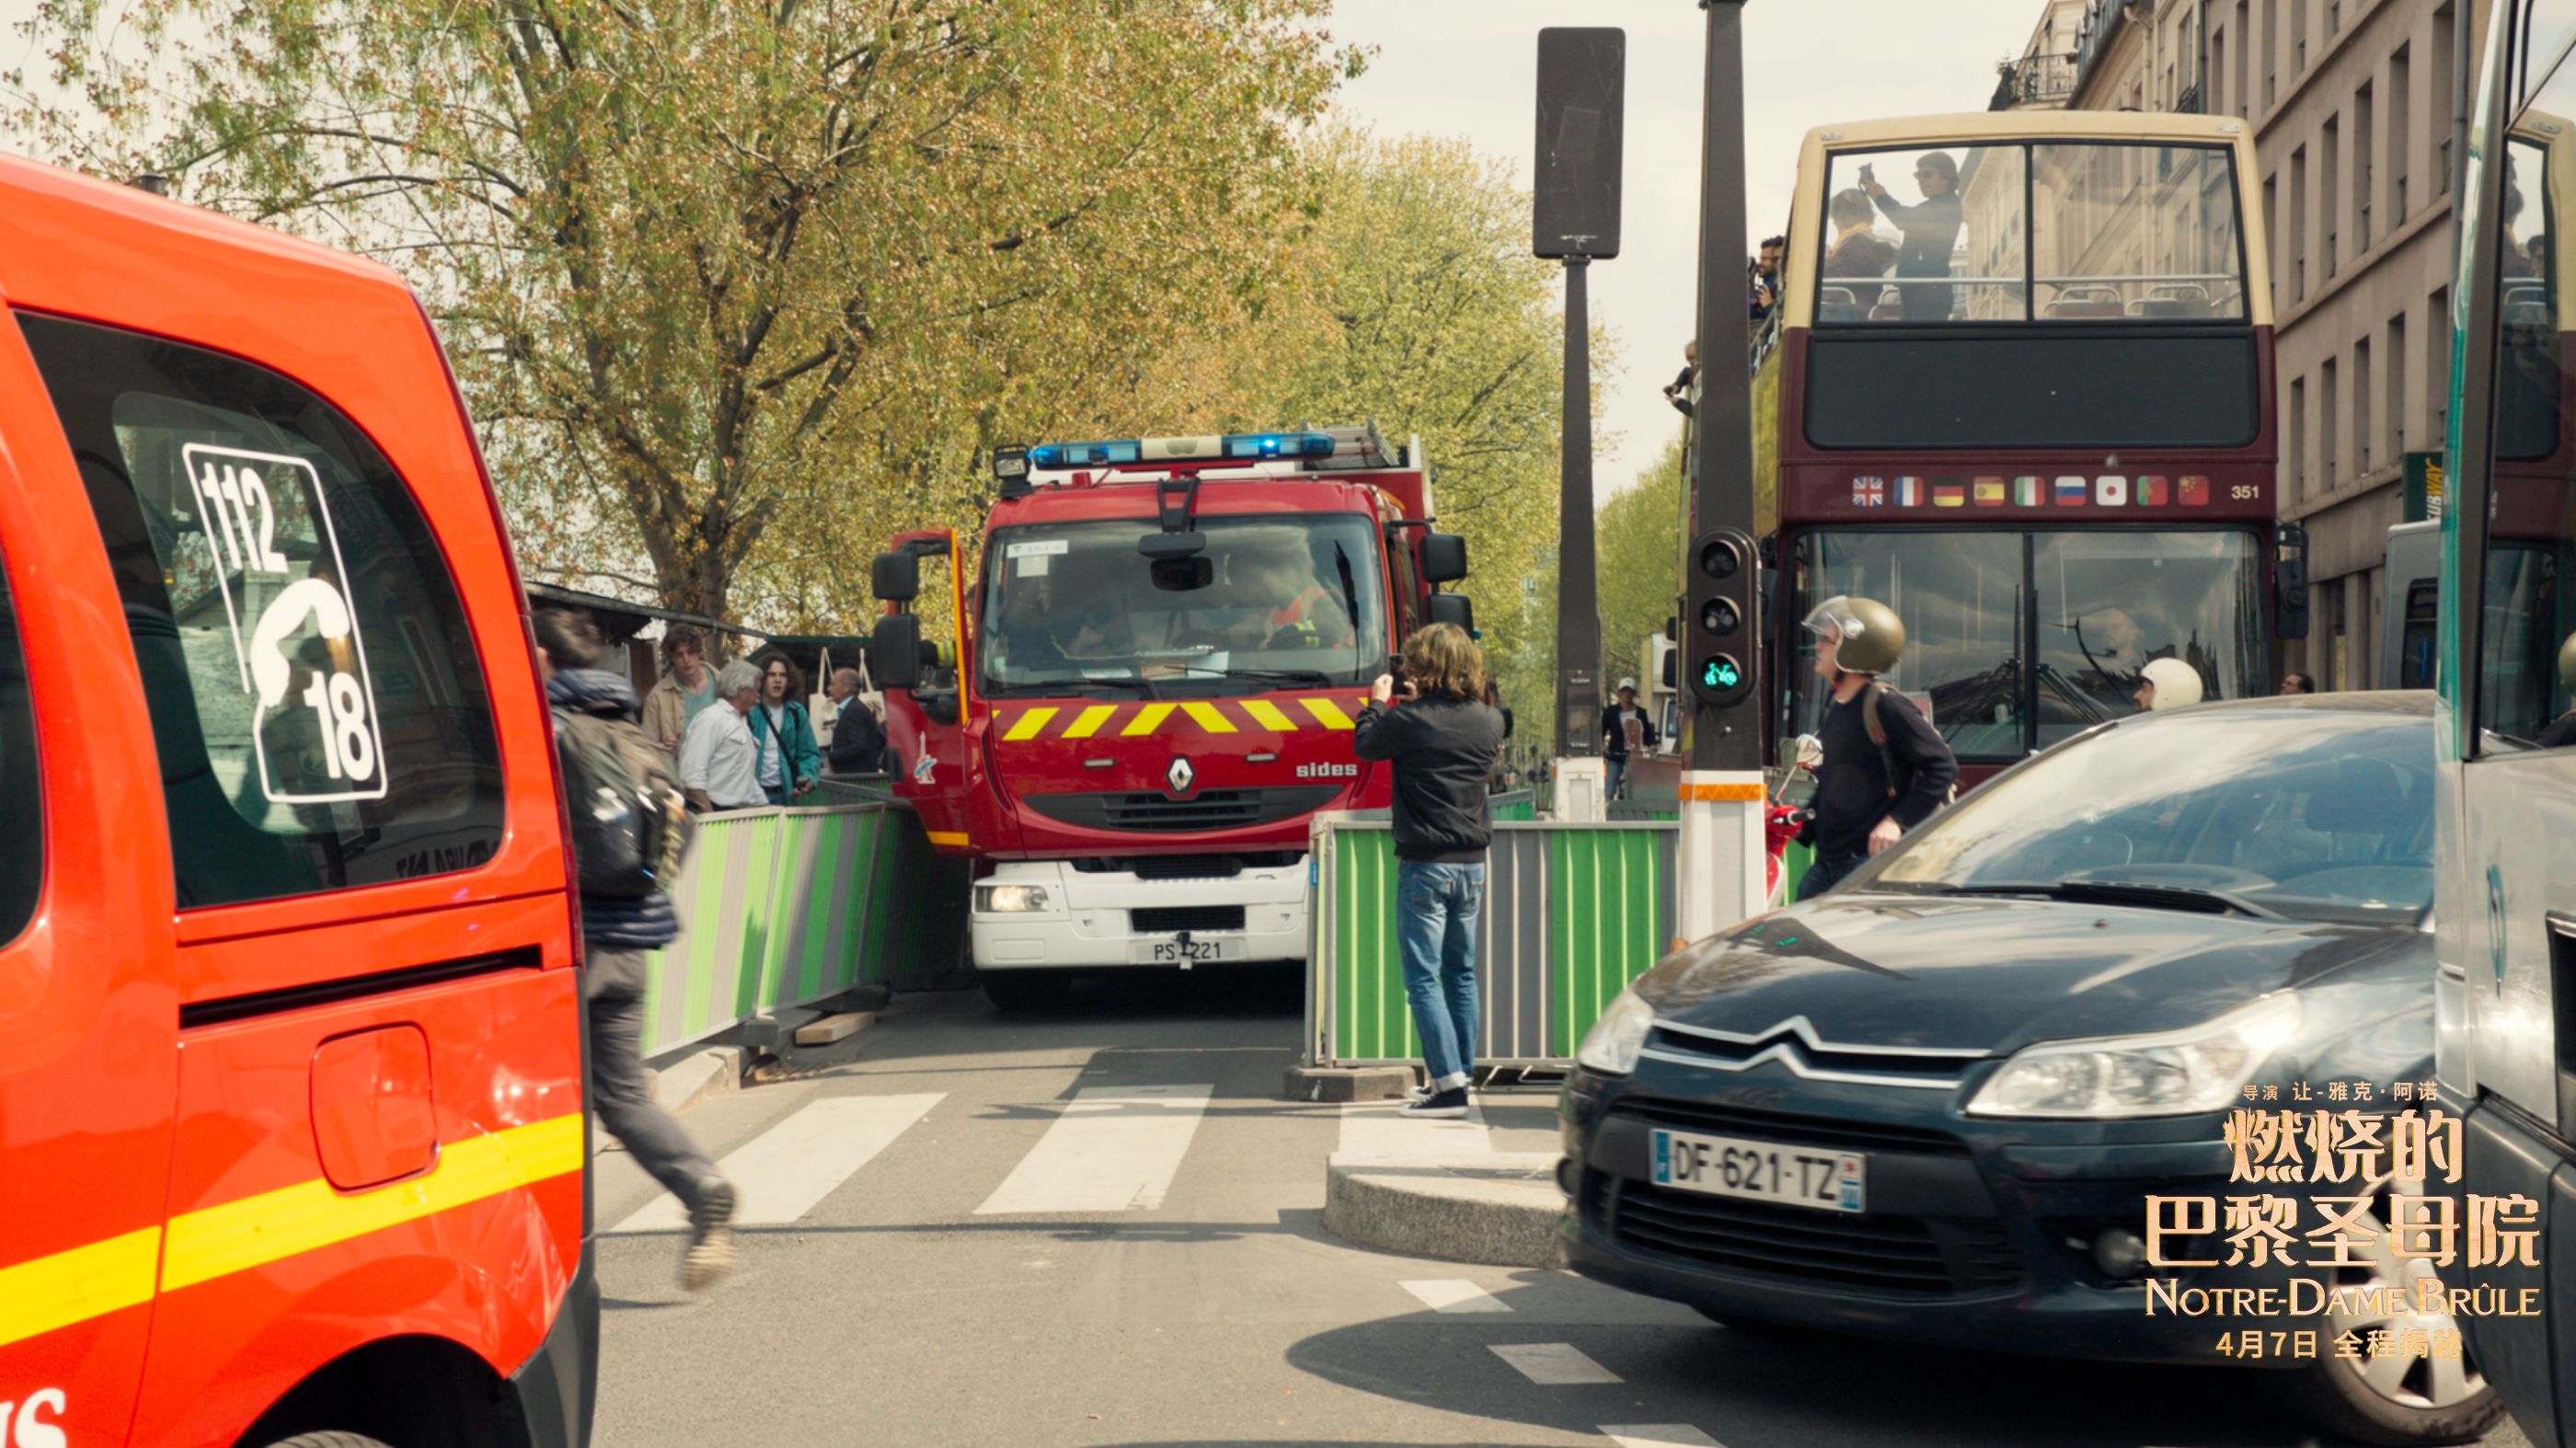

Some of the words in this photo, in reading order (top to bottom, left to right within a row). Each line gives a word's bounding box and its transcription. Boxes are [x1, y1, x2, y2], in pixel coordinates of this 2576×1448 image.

[201, 462, 289, 573] 112
[2231, 485, 2260, 500] 351
[303, 671, 374, 781] 18
[1295, 762, 1358, 778] sides
